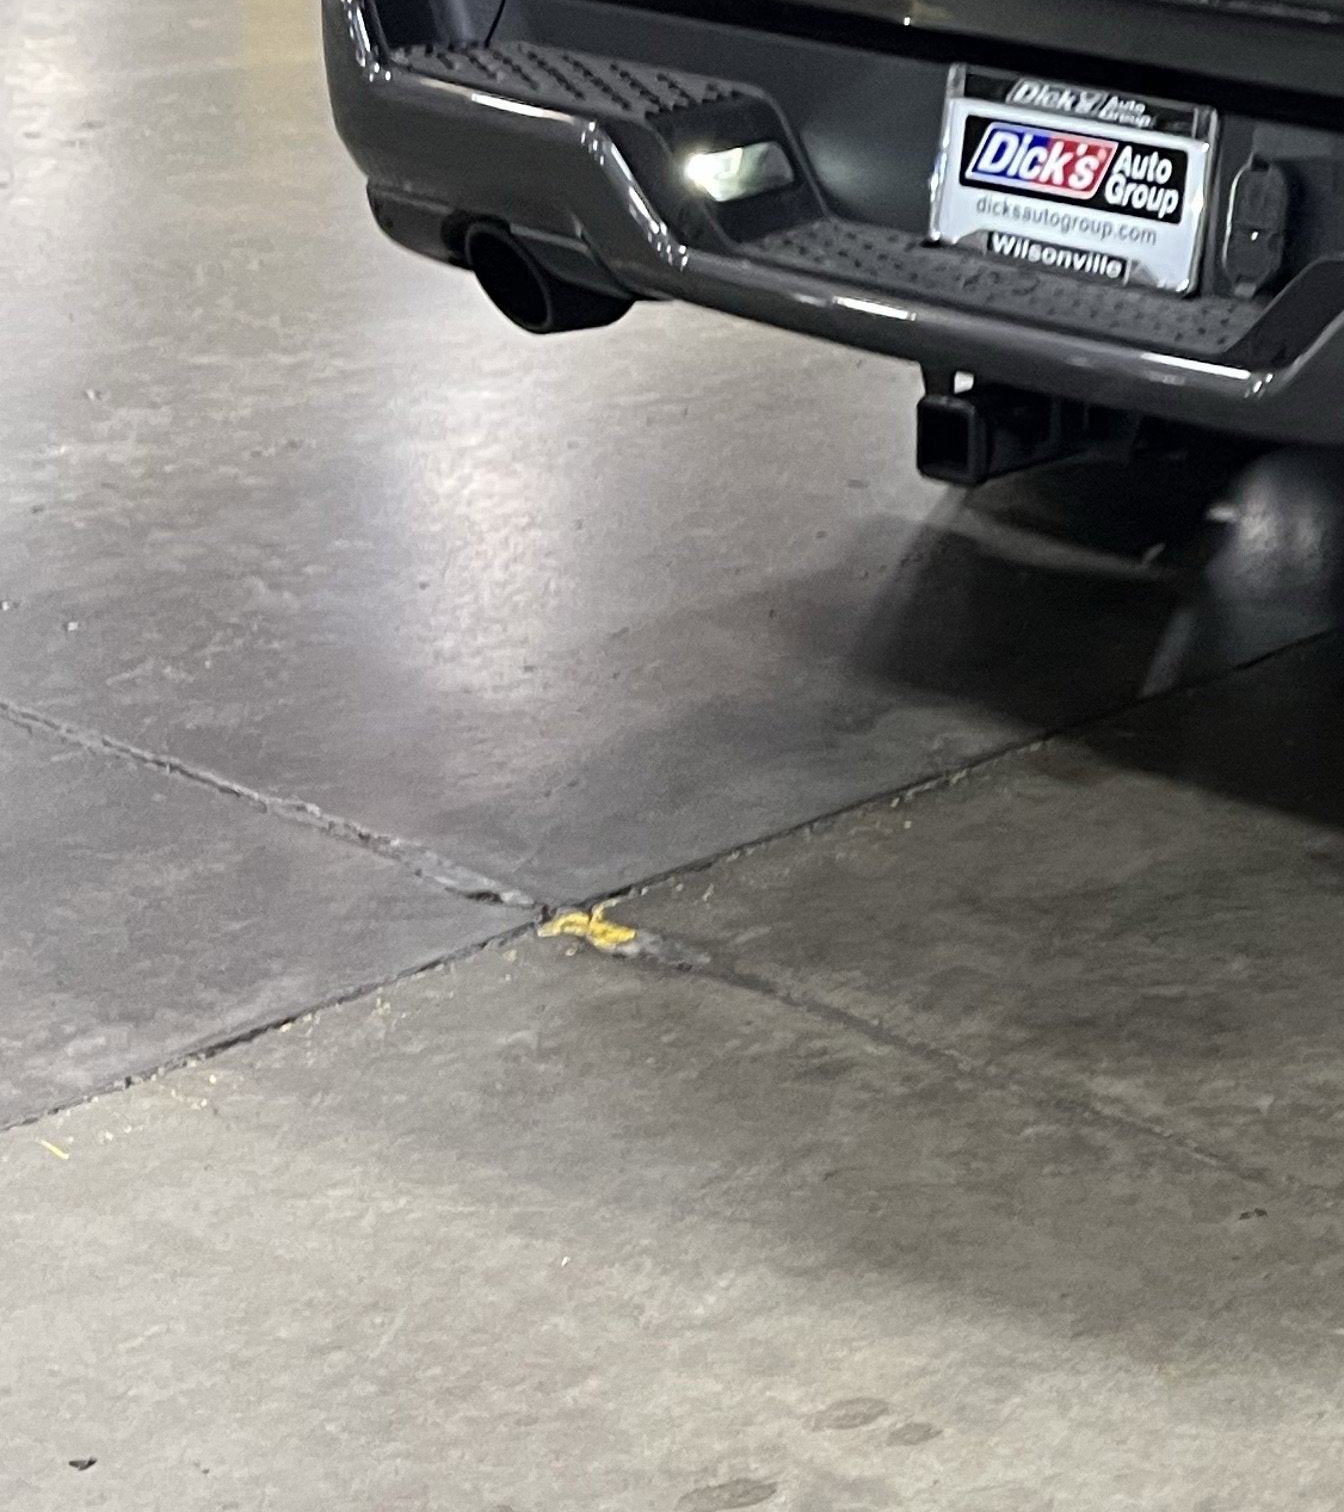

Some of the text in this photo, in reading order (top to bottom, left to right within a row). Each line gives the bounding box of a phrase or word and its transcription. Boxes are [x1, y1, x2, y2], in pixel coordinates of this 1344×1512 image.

[1102, 95, 1147, 115] Auto
[976, 130, 1173, 190] Dick's Auto
[975, 195, 1157, 246] dicksautogroup.com
[1104, 176, 1180, 219] Group
[990, 232, 1123, 279] Wilsonville
